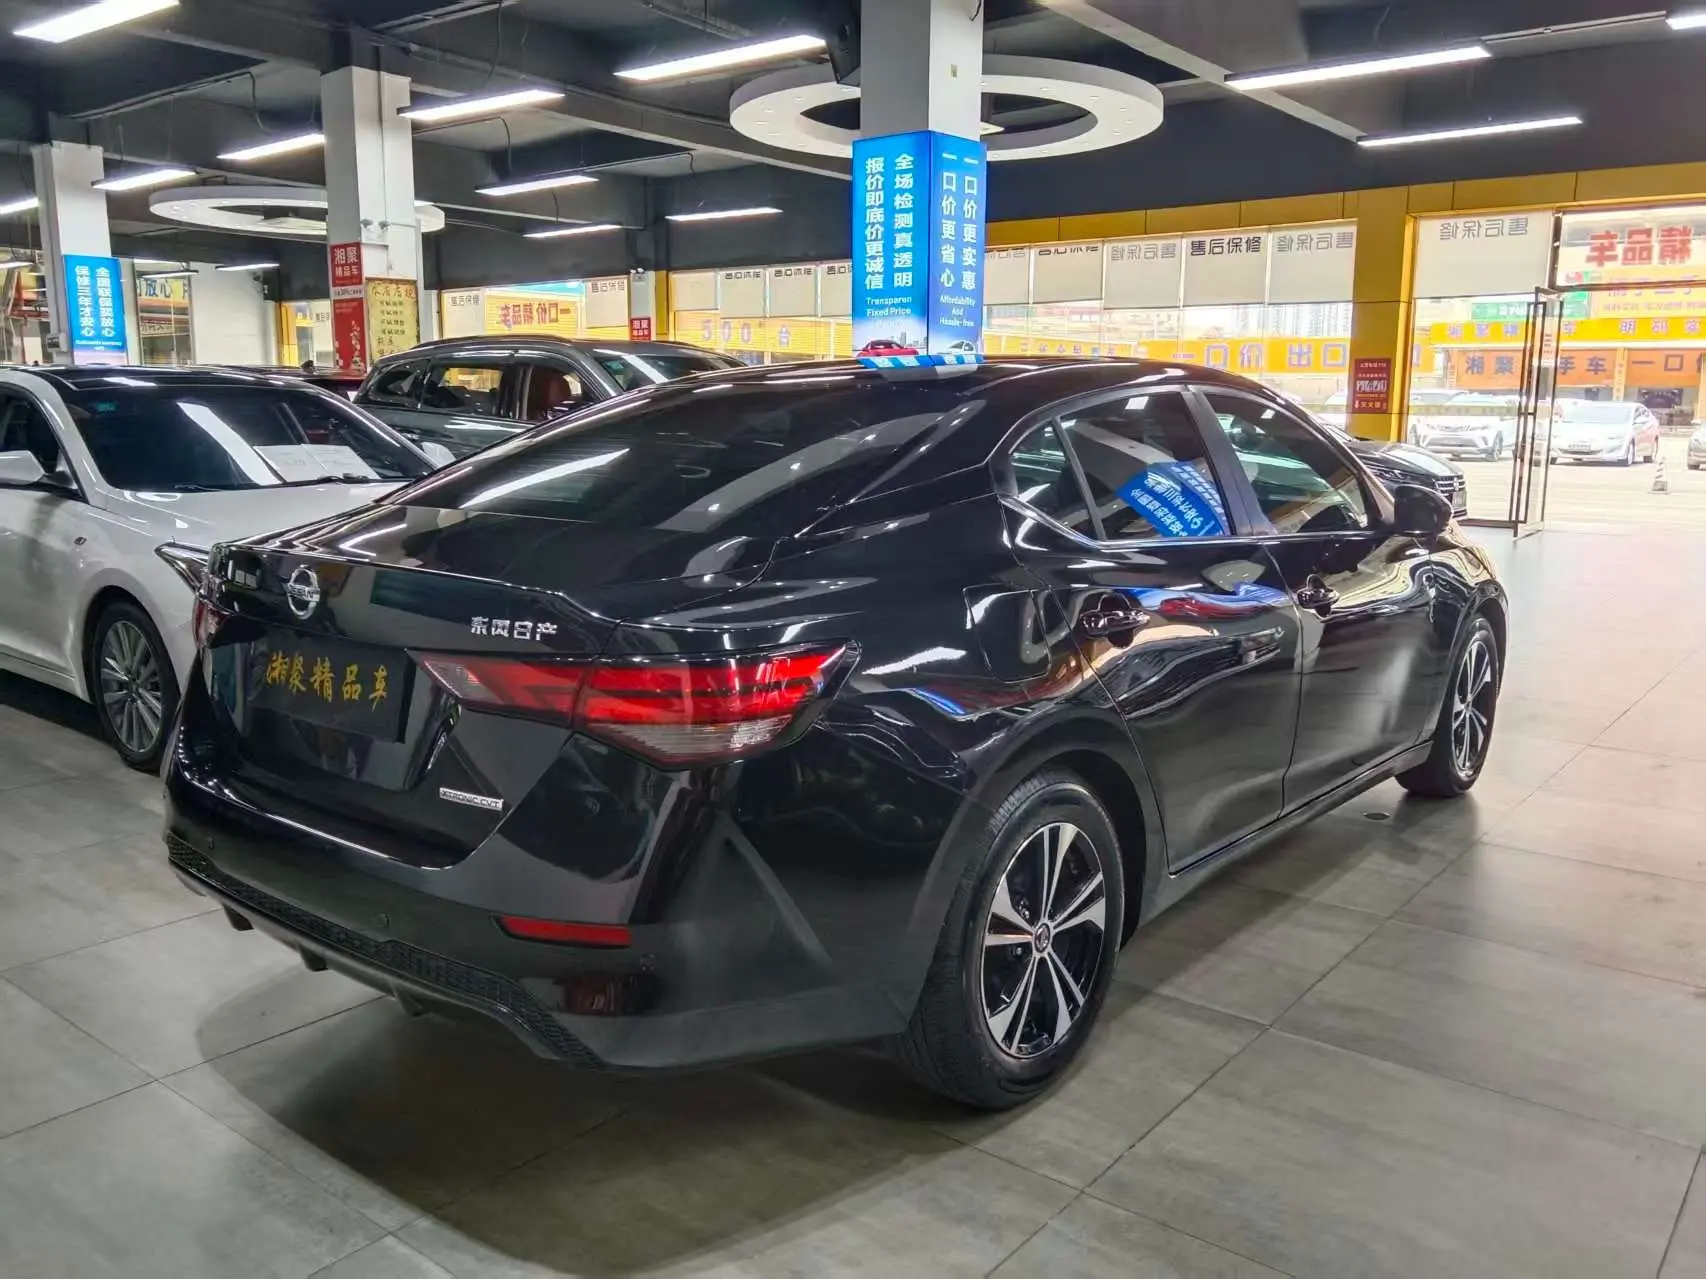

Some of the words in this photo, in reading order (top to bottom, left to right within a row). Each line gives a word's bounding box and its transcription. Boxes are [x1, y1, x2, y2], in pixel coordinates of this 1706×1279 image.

[865, 157, 885, 290] 报价即底价更诚信
[893, 153, 915, 287] 全场检测真透明
[940, 152, 958, 288] 一口价更省心
[960, 157, 980, 290] 一口价更实惠
[334, 247, 358, 264] 湘聚
[1190, 236, 1263, 257] 售后保修
[866, 308, 889, 318] Fixed
[890, 306, 912, 316] Price
[470, 615, 558, 641] 东风日产
[266, 650, 390, 713] 湘聚精品车
[480, 798, 500, 810] CVT
